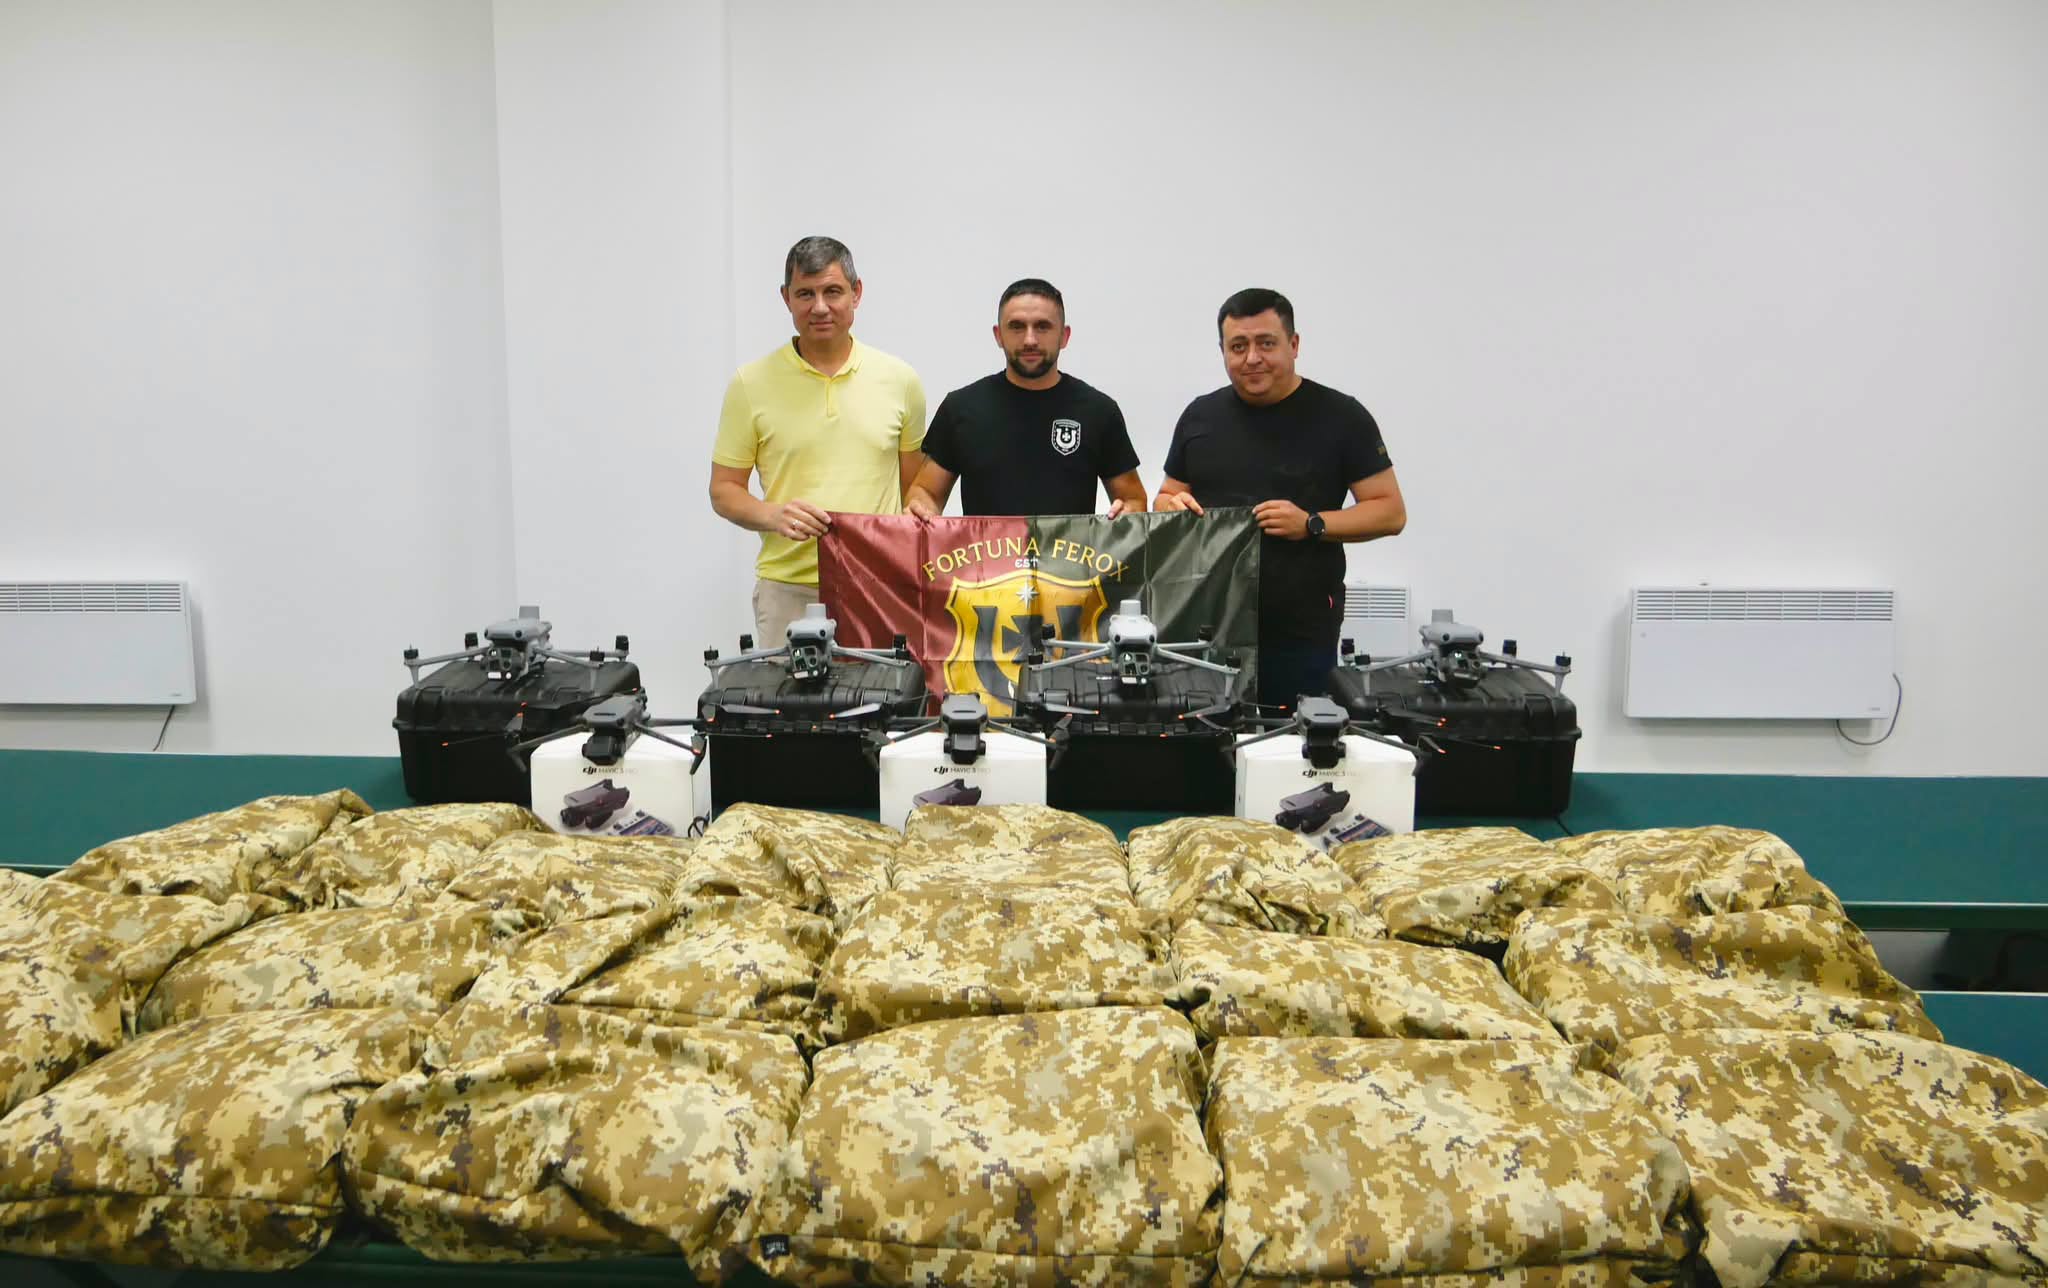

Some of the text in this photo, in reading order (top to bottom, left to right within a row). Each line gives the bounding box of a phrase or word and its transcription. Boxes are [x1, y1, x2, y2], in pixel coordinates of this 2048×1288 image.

[922, 537, 1130, 583] FORTUNA FEROX
[1014, 555, 1040, 569] EST
